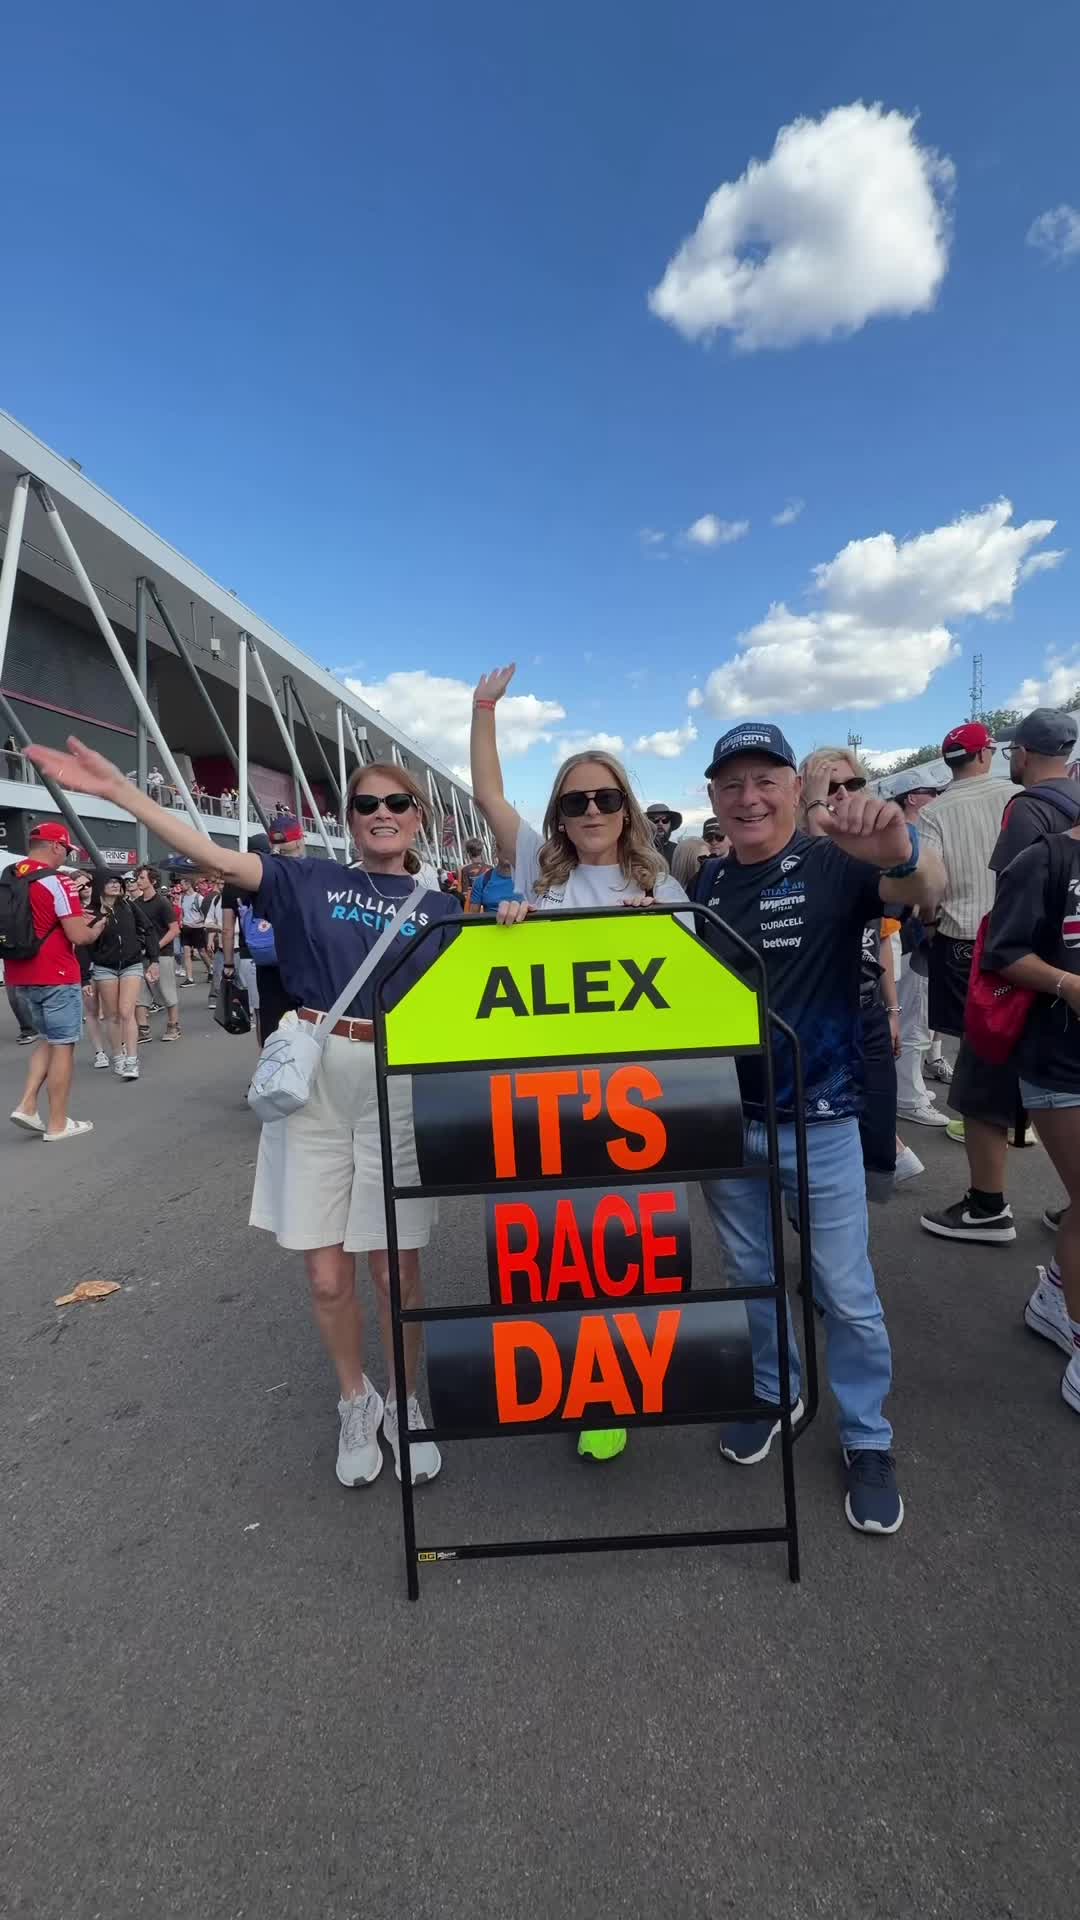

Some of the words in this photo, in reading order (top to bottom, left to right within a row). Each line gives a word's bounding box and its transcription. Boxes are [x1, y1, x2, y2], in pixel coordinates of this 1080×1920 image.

[760, 917, 804, 931] DURACELL
[762, 936, 802, 949] betway
[476, 958, 670, 1019] ALEX
[489, 1065, 667, 1178] IT'S
[494, 1191, 682, 1304] RACE
[492, 1310, 681, 1424] DAY
